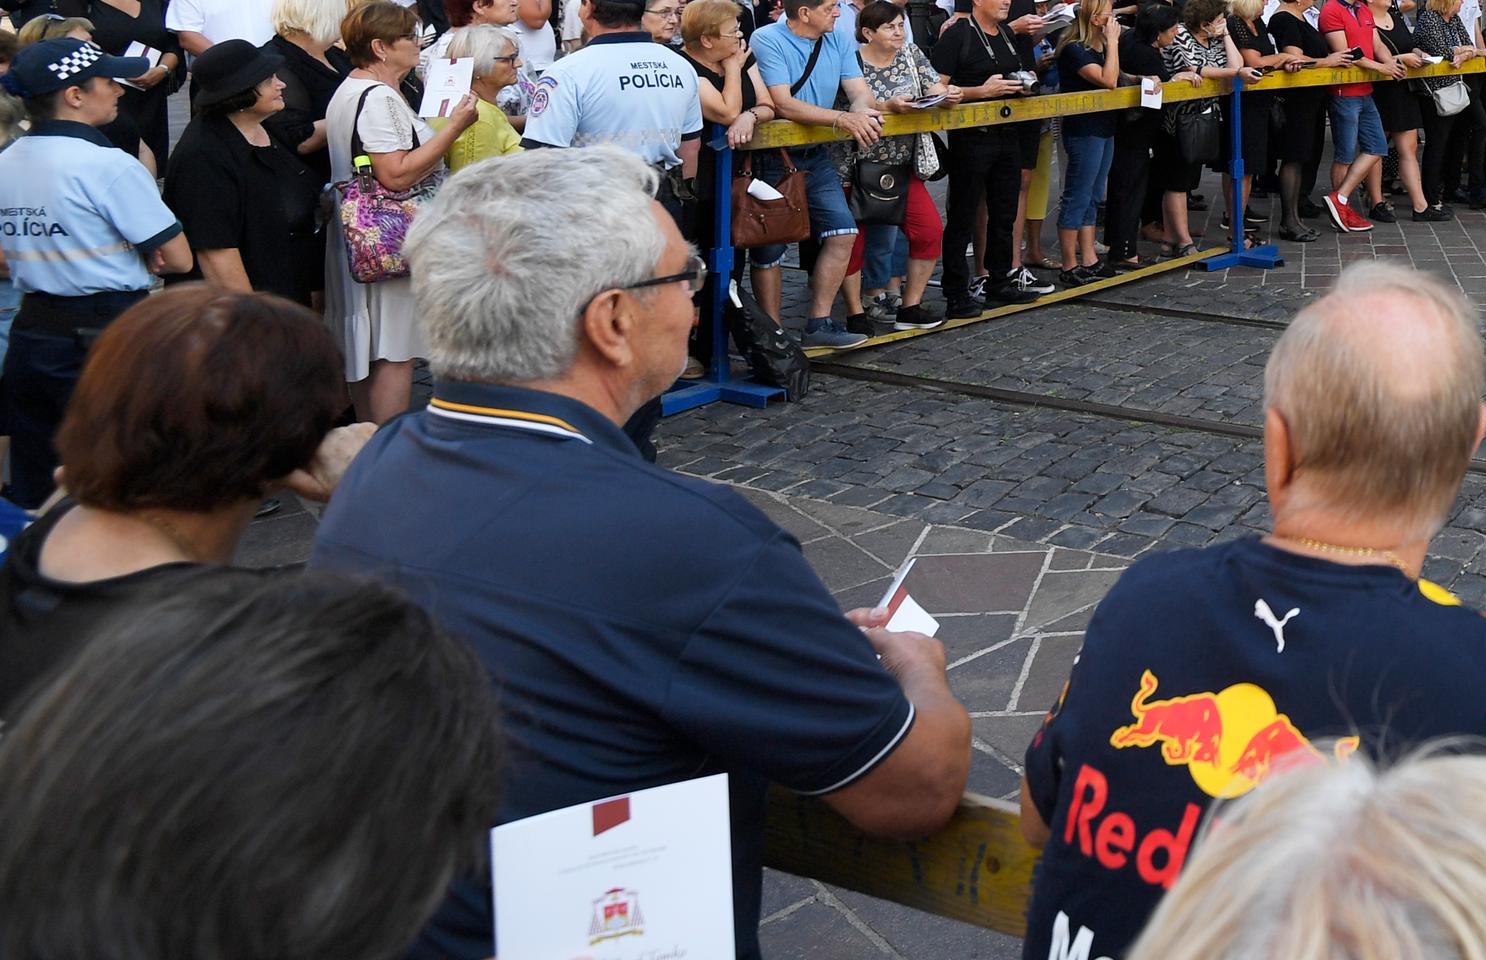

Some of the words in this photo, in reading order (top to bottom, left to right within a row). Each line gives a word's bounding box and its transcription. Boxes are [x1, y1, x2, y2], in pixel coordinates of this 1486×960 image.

[630, 61, 668, 69] MESTSKÁ
[619, 70, 684, 90] POLÍCIA
[1063, 763, 1201, 890] Red
